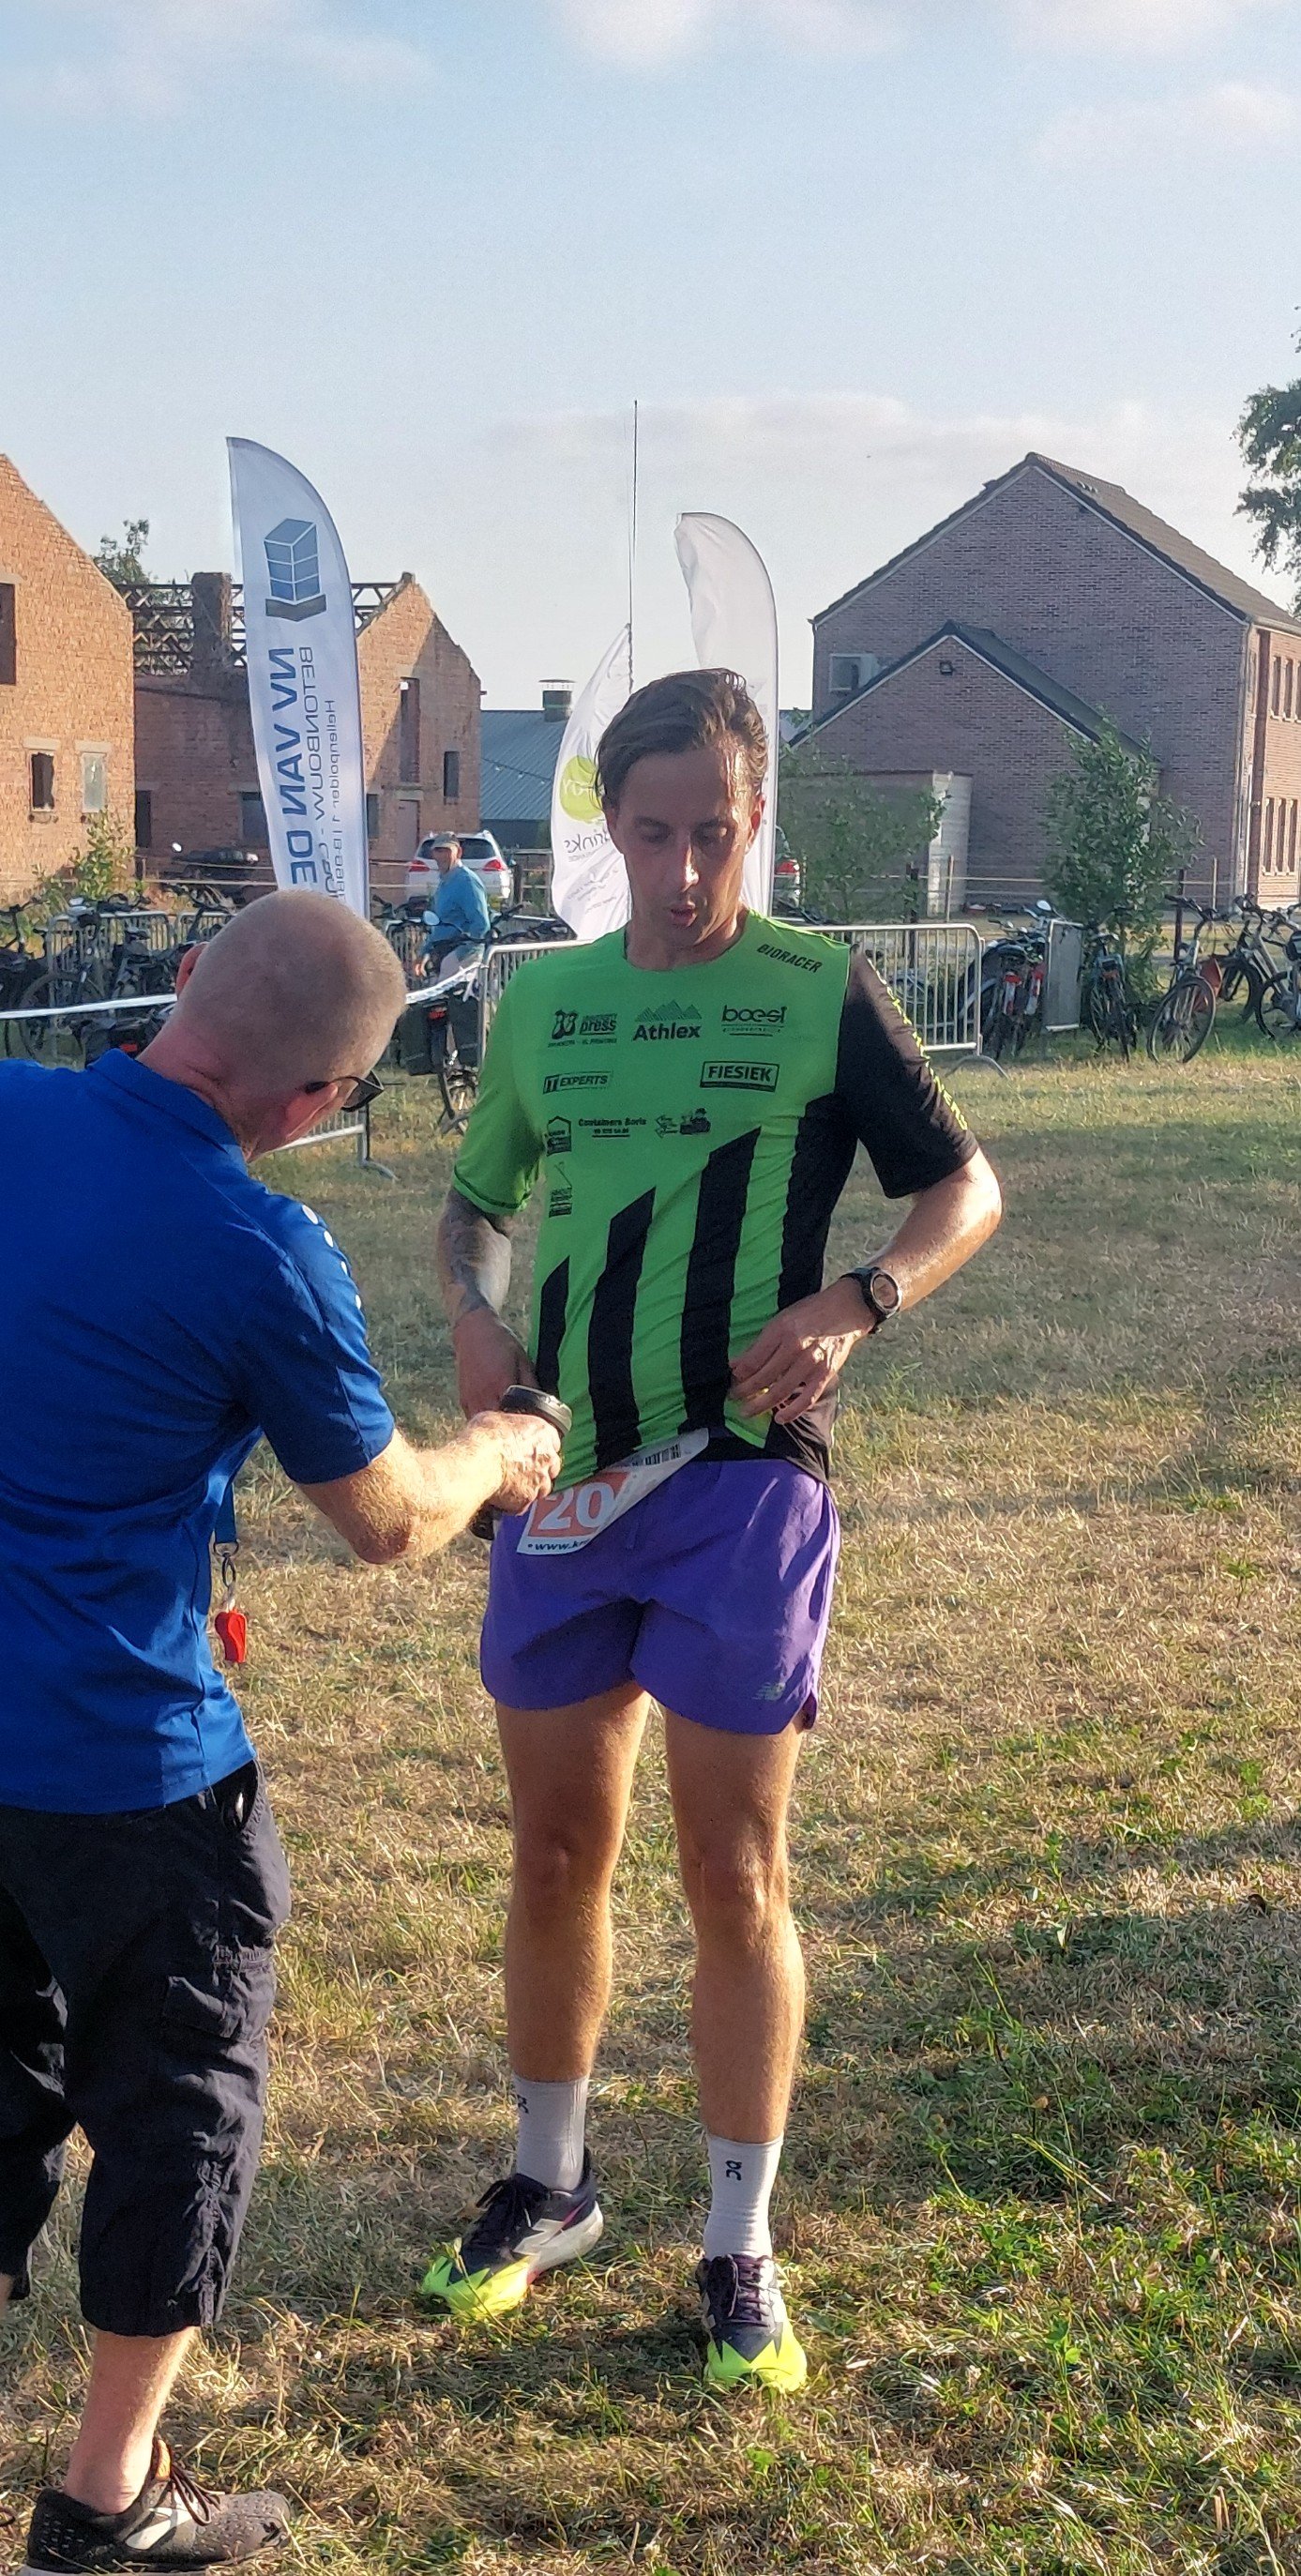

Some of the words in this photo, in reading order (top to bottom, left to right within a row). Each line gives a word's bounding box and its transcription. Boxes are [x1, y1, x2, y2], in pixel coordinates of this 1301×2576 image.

[756, 943, 823, 974] BIORACER
[631, 1022, 702, 1042] Athlex
[560, 1075, 609, 1087] EXPERTS
[708, 1066, 772, 1083] FIESIEK
[537, 1482, 615, 1531] 20
